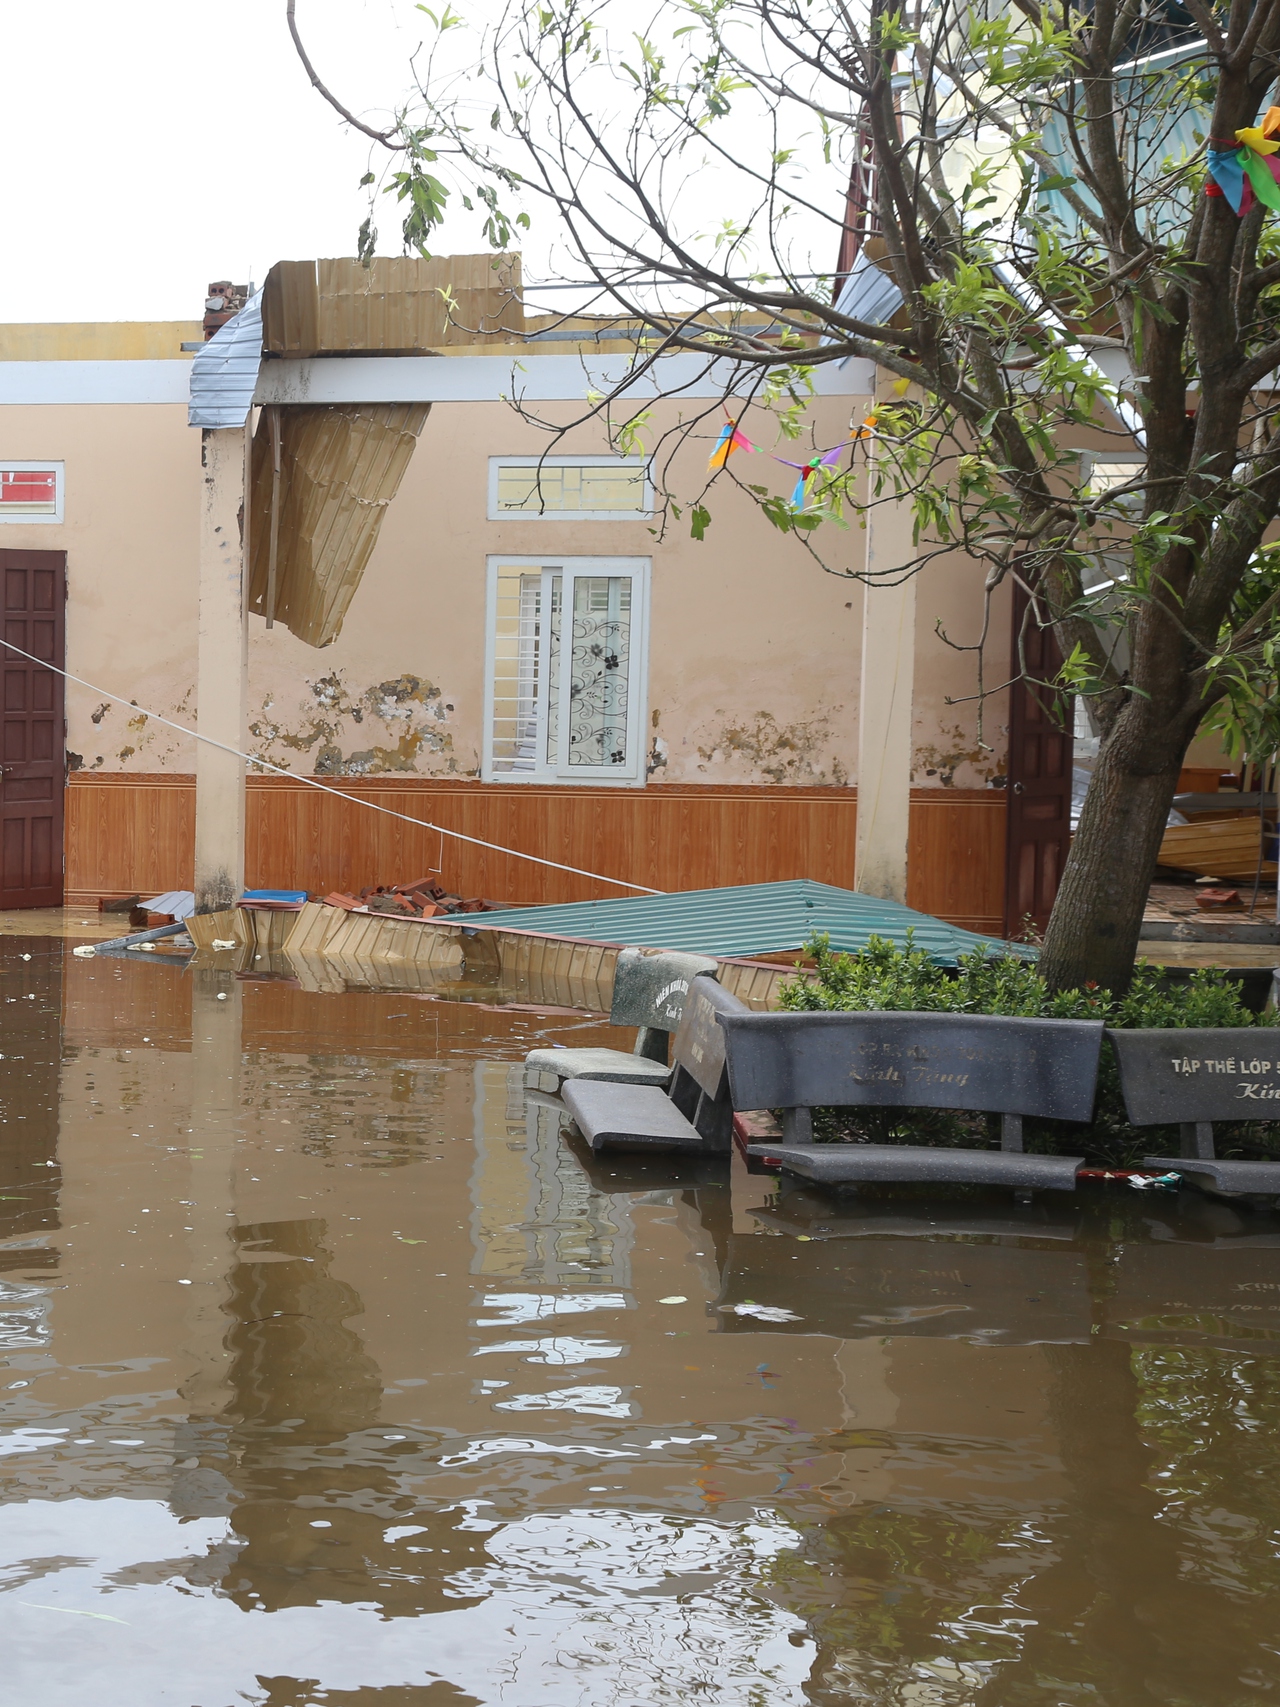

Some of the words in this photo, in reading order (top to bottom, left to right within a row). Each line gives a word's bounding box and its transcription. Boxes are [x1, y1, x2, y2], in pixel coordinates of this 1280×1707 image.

[1171, 1056, 1201, 1076] TẬP
[1204, 1056, 1236, 1074] THỂ
[1240, 1058, 1271, 1074] LỚP
